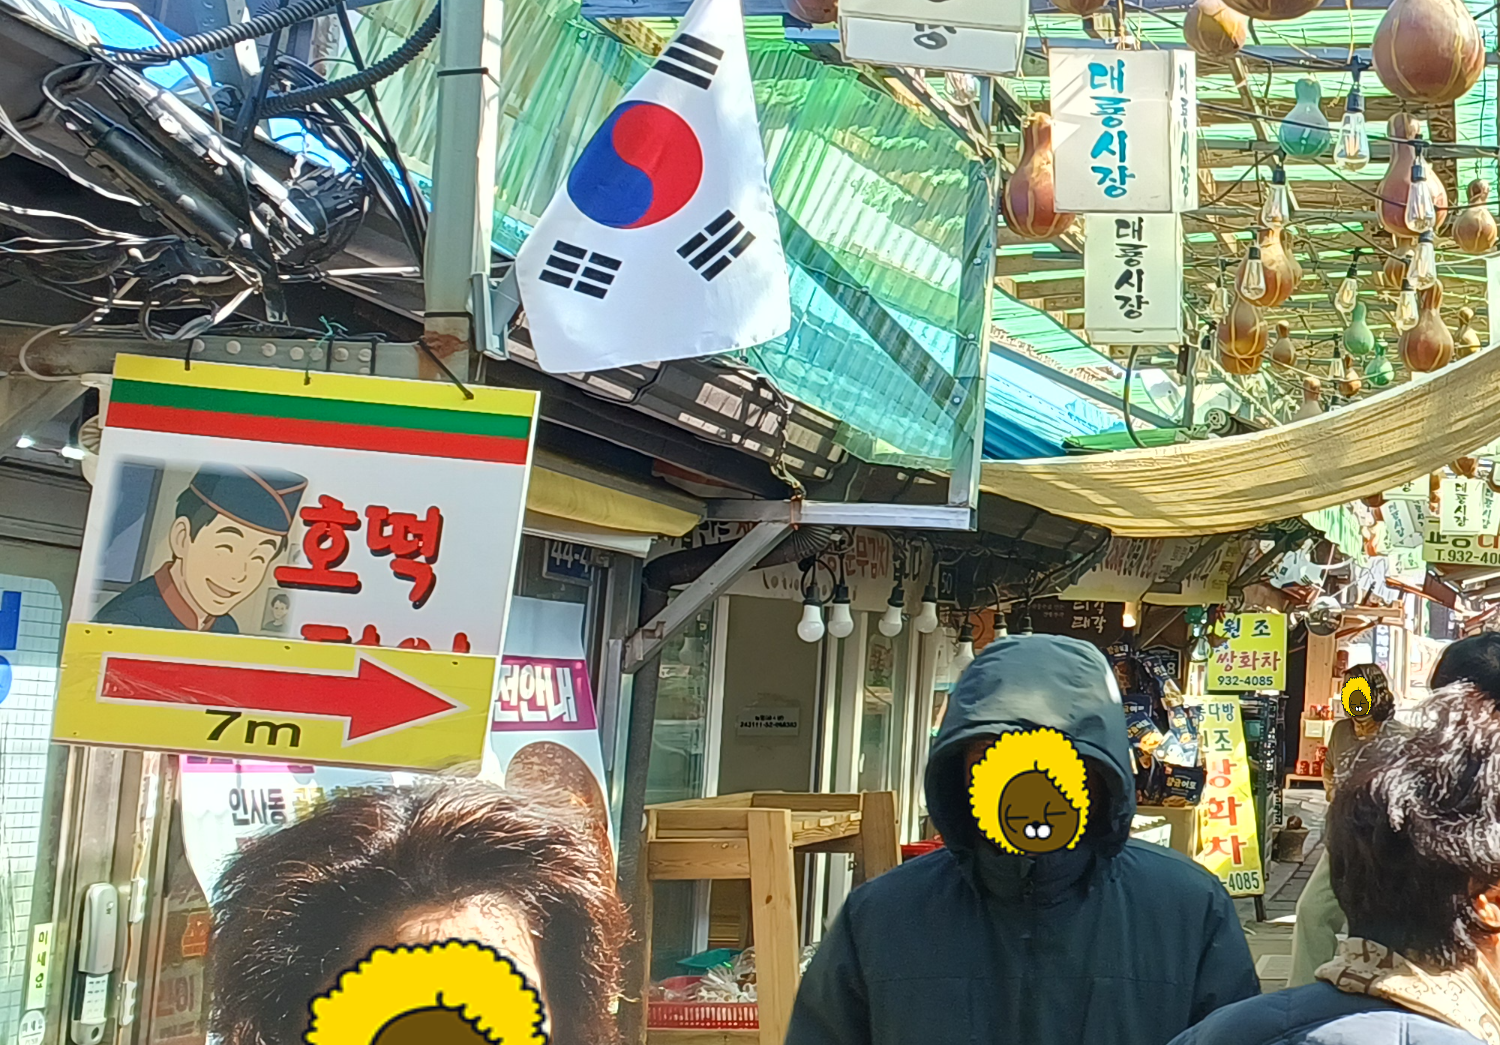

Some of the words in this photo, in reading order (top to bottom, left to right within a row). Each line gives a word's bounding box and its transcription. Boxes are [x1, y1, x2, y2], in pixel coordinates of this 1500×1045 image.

[1087, 59, 1136, 199] 대룡시장
[1114, 217, 1152, 320] 대룡시장
[274, 494, 444, 611] 호떡
[1215, 650, 1281, 672] 쌍화차
[1217, 675, 1274, 687] 932-4085
[203, 708, 303, 748] 7m
[228, 787, 288, 827] 인사동
